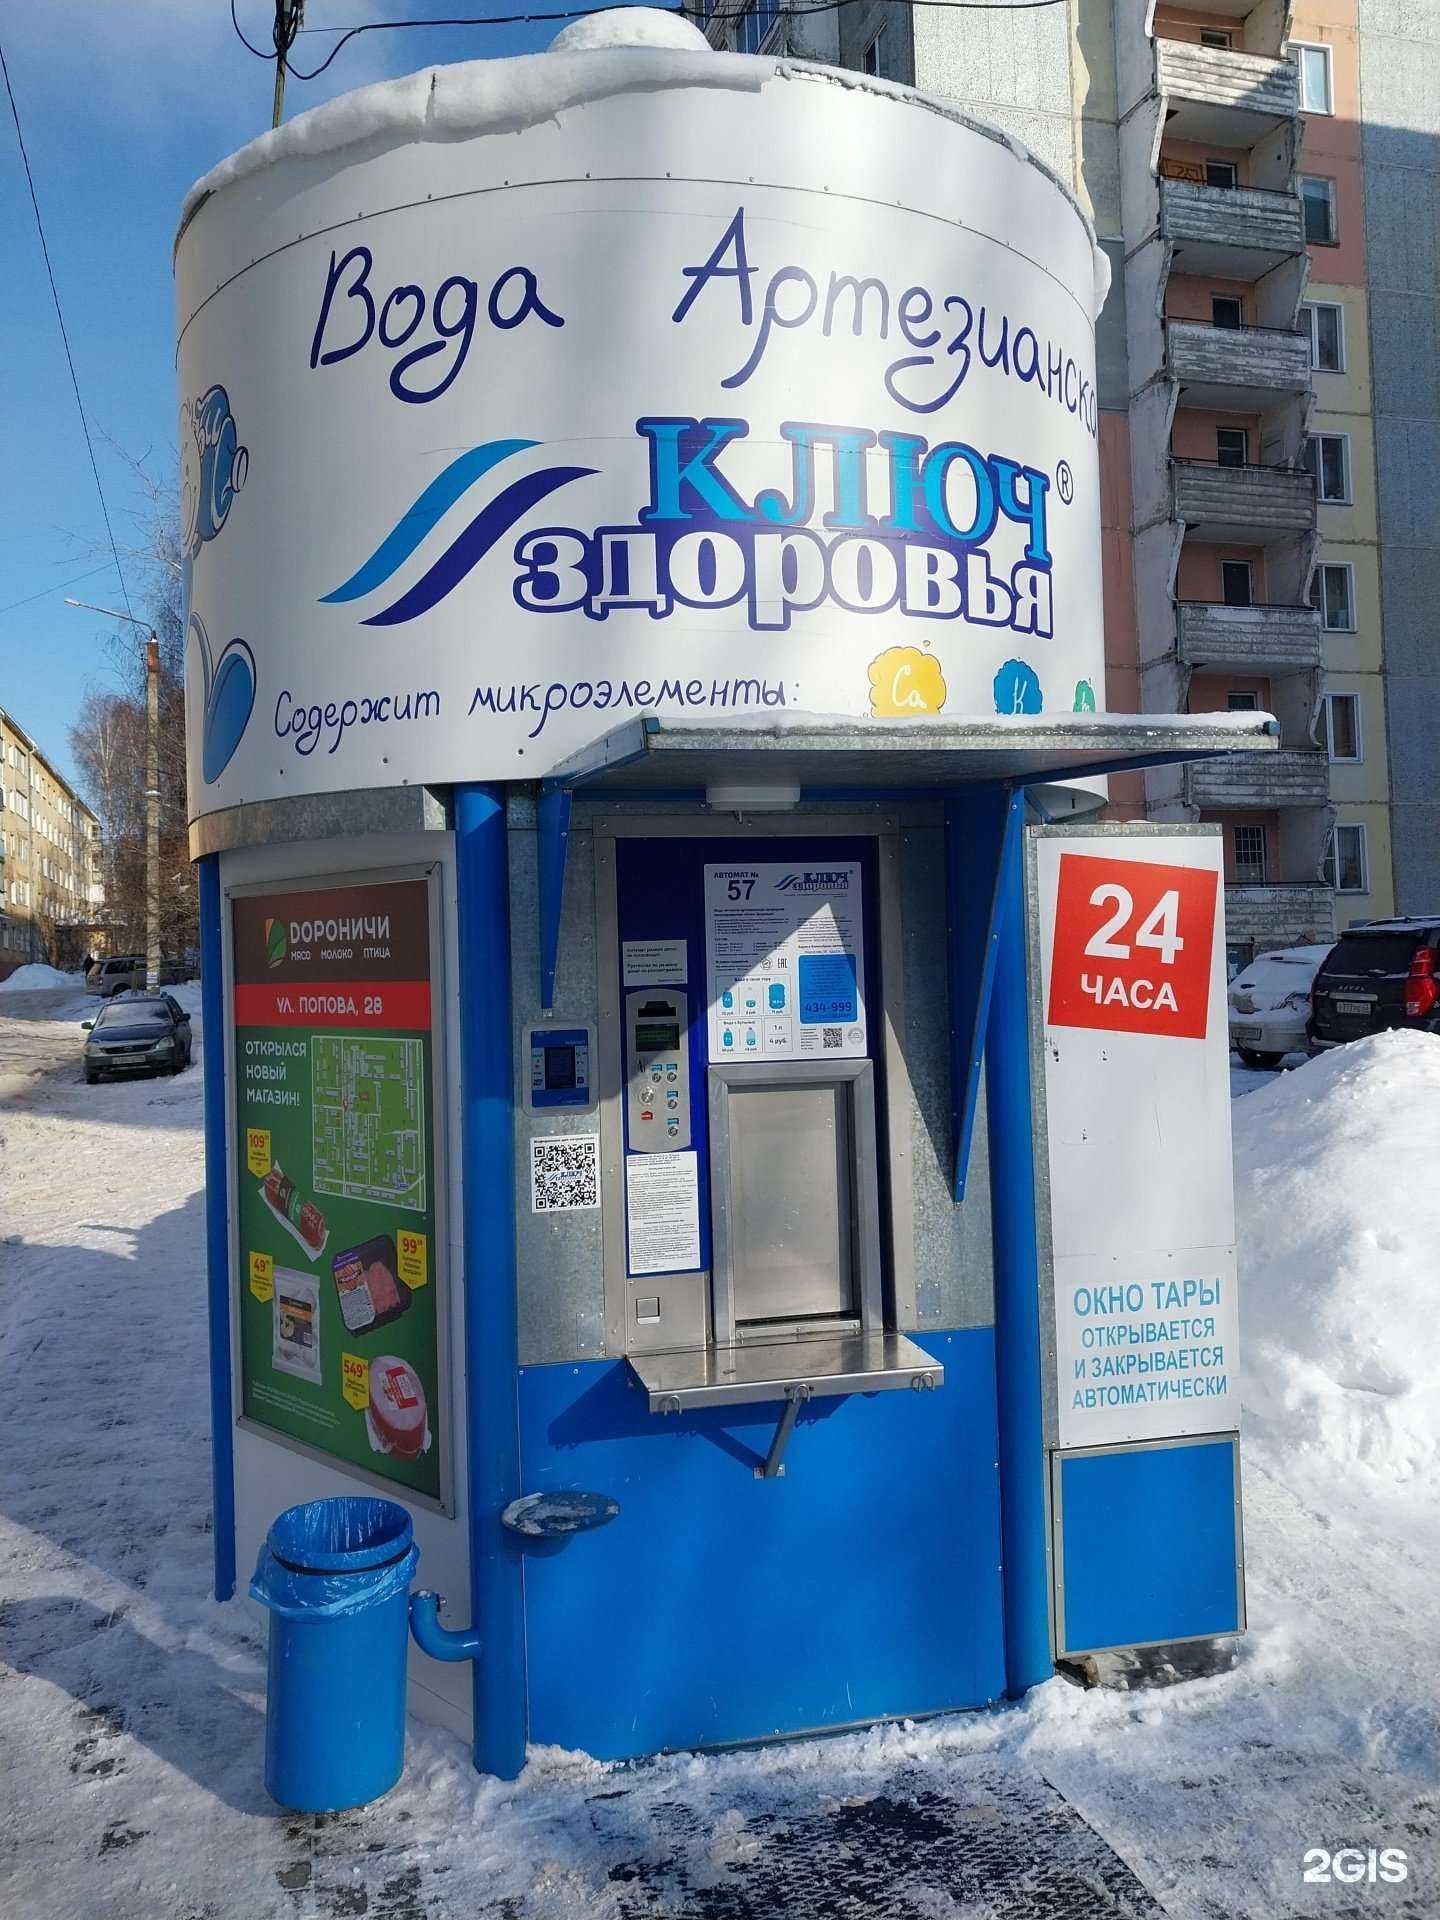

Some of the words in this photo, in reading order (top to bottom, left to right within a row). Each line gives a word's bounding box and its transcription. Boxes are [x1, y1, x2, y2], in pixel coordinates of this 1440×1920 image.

[309, 246, 565, 404] Вода
[635, 417, 1051, 564] КЛЮЧ
[274, 689, 441, 755] Содержит
[468, 677, 801, 739] микроэлементы:
[727, 880, 756, 901] 57
[1083, 883, 1185, 965] 24
[321, 948, 353, 960] МОЛОКО
[363, 947, 391, 959] ПТИЦА
[299, 996, 359, 1017] ПОПОВА,
[364, 996, 383, 1015] 28
[1080, 973, 1179, 1013] ЧАСА
[245, 1040, 307, 1057] ОТКРЫЛСЯ
[246, 1061, 287, 1081] НОВЫЙ
[246, 1087, 300, 1107] МАГАЗИН!
[1073, 1283, 1144, 1317] ОКНО
[1151, 1277, 1221, 1310] ТАРЫ
[1081, 1317, 1216, 1349] ОТКРЫВАЕТСЯ
[1074, 1358, 1086, 1380] И
[1092, 1346, 1224, 1379] ЗАКРЫВАЕТСЯ
[1072, 1375, 1228, 1410] АВТОМАТИЧЕСКИ
